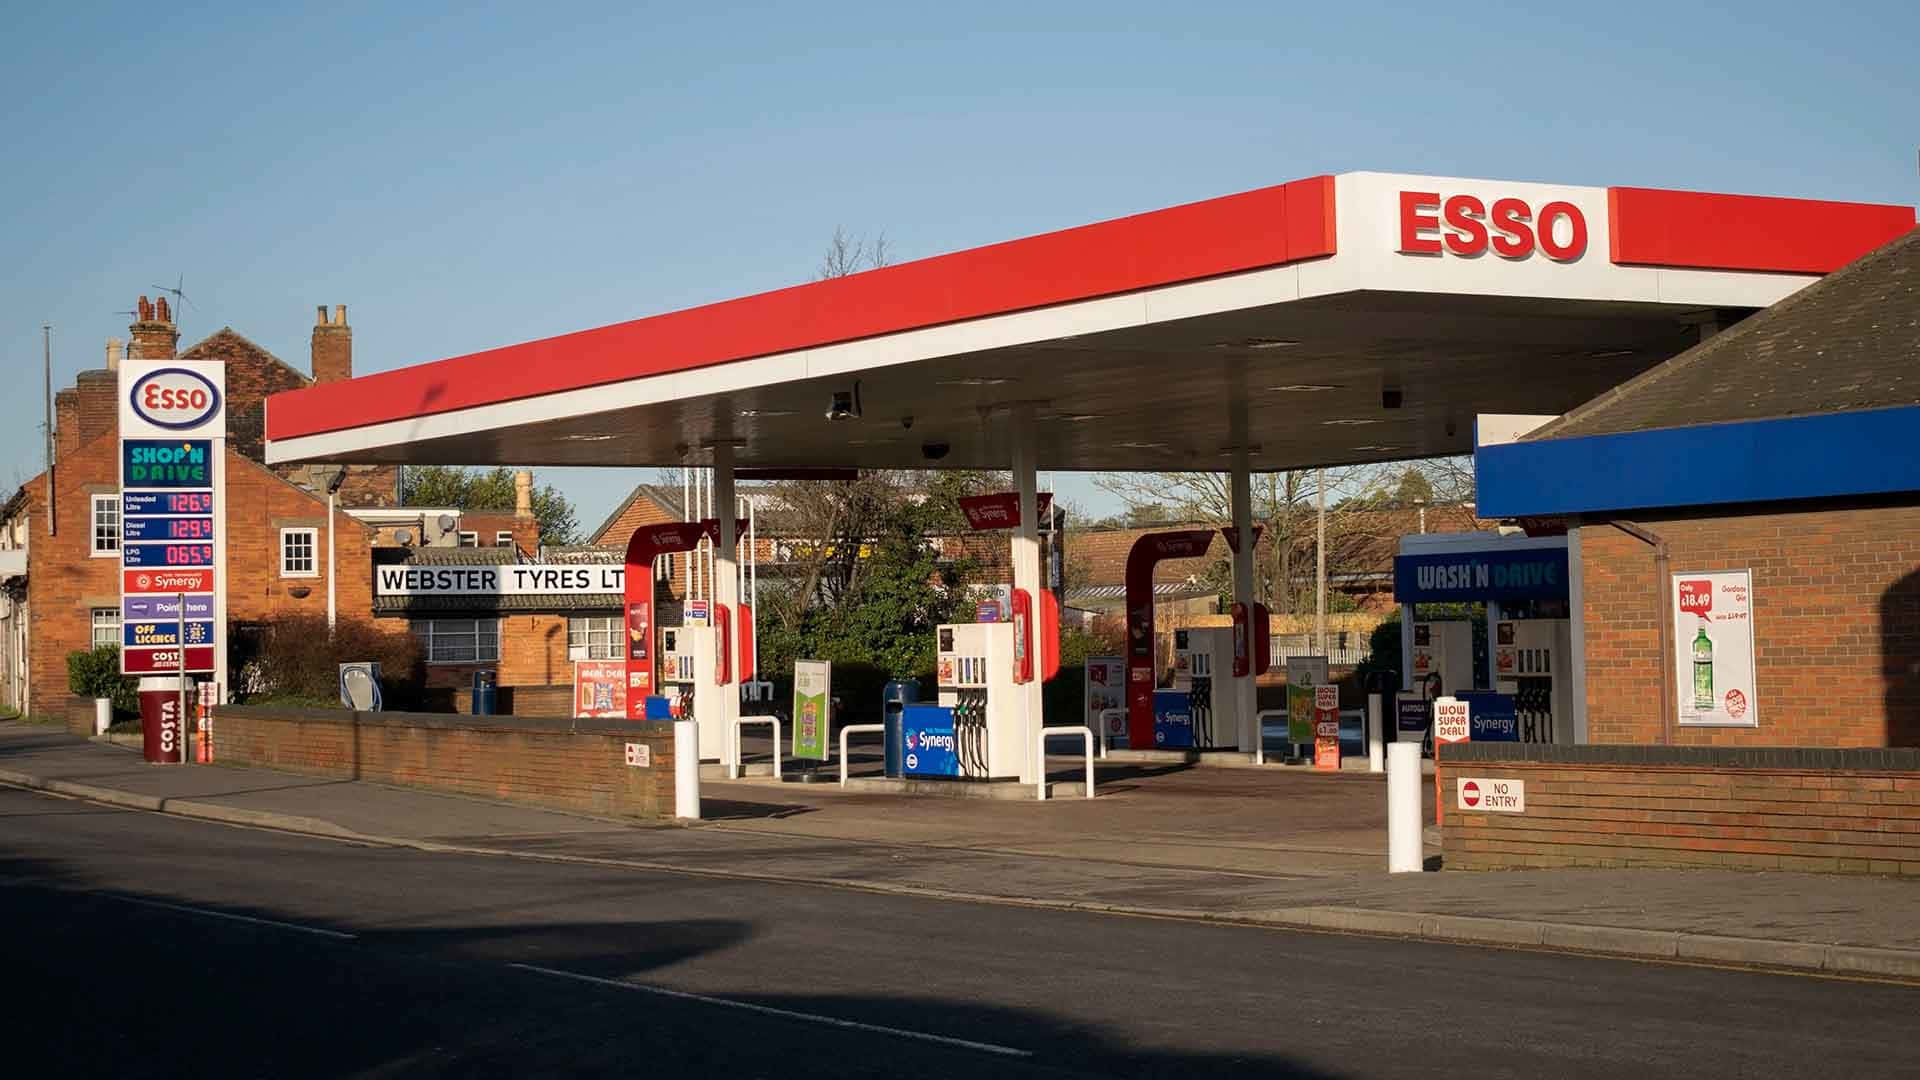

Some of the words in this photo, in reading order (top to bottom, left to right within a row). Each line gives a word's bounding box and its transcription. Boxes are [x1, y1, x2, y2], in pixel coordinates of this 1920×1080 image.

[1400, 191, 1588, 263] ESSO
[144, 383, 208, 410] Esso
[131, 443, 204, 464] SHOP'N
[131, 465, 205, 481] DRIVE
[172, 493, 212, 512] 126.9
[172, 520, 212, 538] 129.9
[125, 548, 140, 556] LPG
[167, 546, 212, 564] 065.9
[155, 575, 202, 590] Synergy
[382, 570, 496, 590] WEBSTER
[514, 570, 589, 589] TYRES
[1494, 562, 1557, 589] DRIVE
[186, 604, 207, 612] here
[1680, 594, 1711, 607] £18.49
[135, 625, 156, 635] OFF
[135, 635, 176, 644] LICENCE
[152, 652, 179, 661] COST
[1438, 705, 1466, 715] WOW
[161, 701, 176, 752] COSTA
[1438, 716, 1466, 726] SUPER
[1474, 715, 1515, 734] Synergy
[1440, 726, 1465, 736] DEAL!
[920, 731, 954, 752] Synergy
[1494, 783, 1509, 794] NO
[1485, 795, 1518, 807] ENTRY
